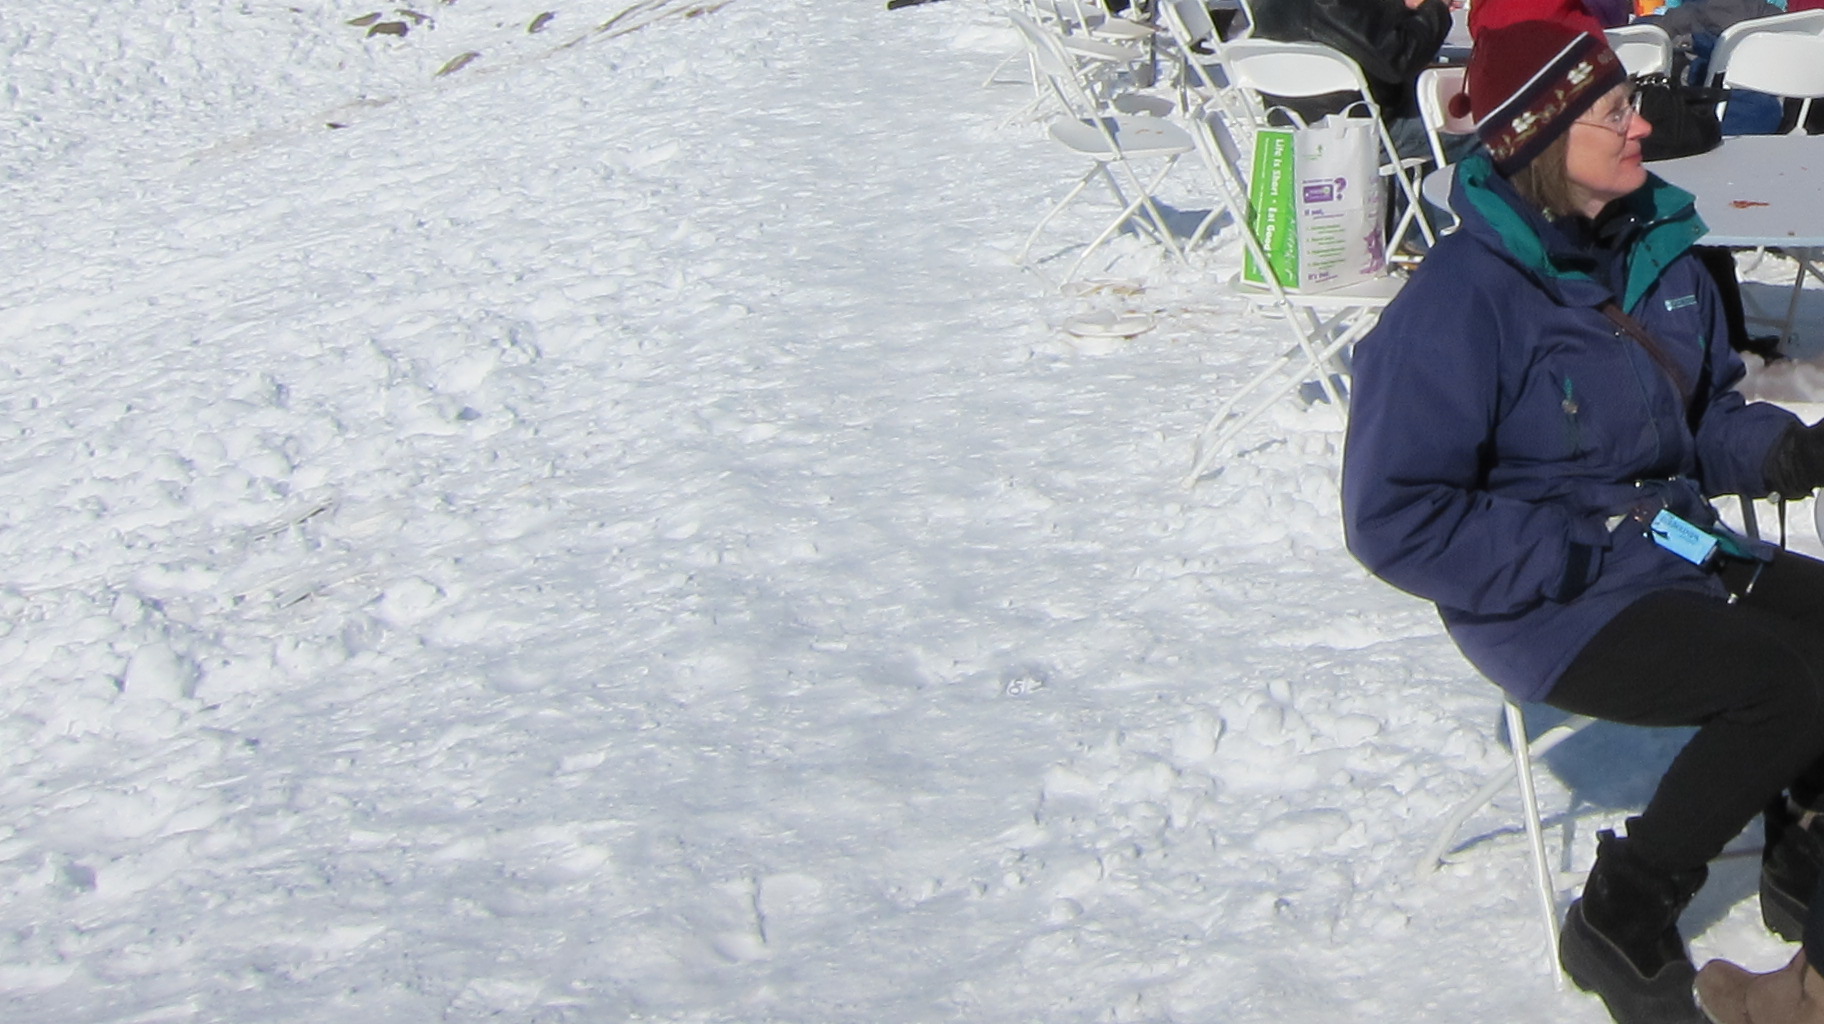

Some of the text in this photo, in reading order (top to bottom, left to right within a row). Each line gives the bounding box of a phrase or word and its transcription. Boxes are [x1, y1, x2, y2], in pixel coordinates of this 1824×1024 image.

[1274, 139, 1285, 157] Life
[1273, 158, 1282, 168] Is
[1271, 169, 1281, 196] Short
[1267, 207, 1277, 222] Eat
[1263, 224, 1276, 252] Good
